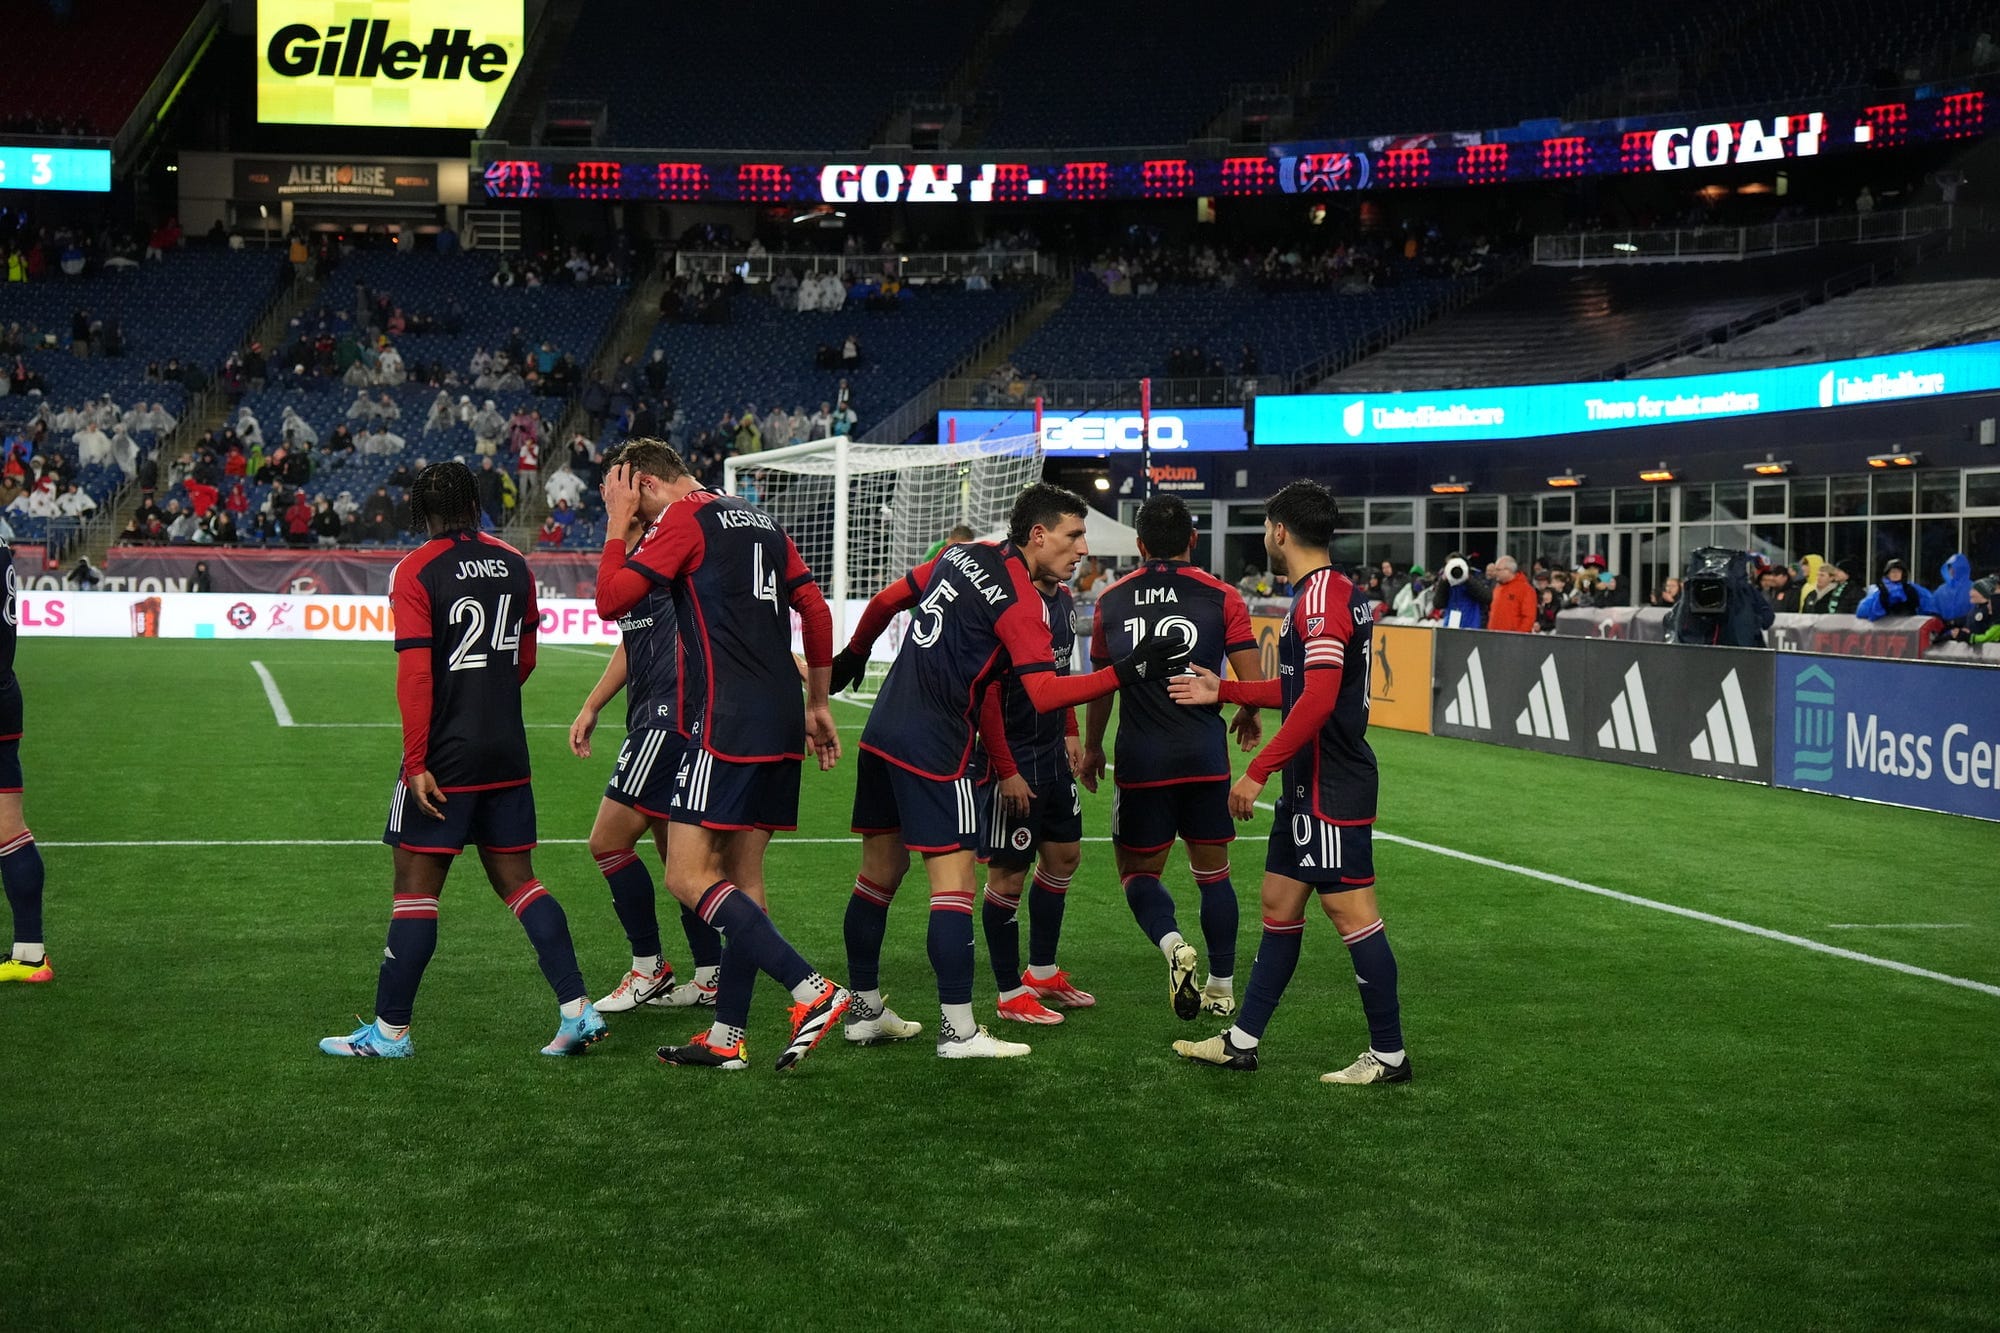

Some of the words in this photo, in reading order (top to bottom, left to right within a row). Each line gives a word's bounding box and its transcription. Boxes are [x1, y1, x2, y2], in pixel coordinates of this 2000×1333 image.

[267, 18, 508, 83] Gillette
[31, 153, 53, 185] 3
[287, 166, 322, 185] ALE
[716, 509, 777, 532] KESSLER
[455, 559, 510, 581] JONES
[752, 542, 779, 617] 4
[943, 546, 1008, 606] CHANCALAY
[1134, 586, 1179, 606] LIMA
[448, 593, 524, 672] 24
[911, 578, 959, 648] 5
[1845, 711, 1933, 780] Mass
